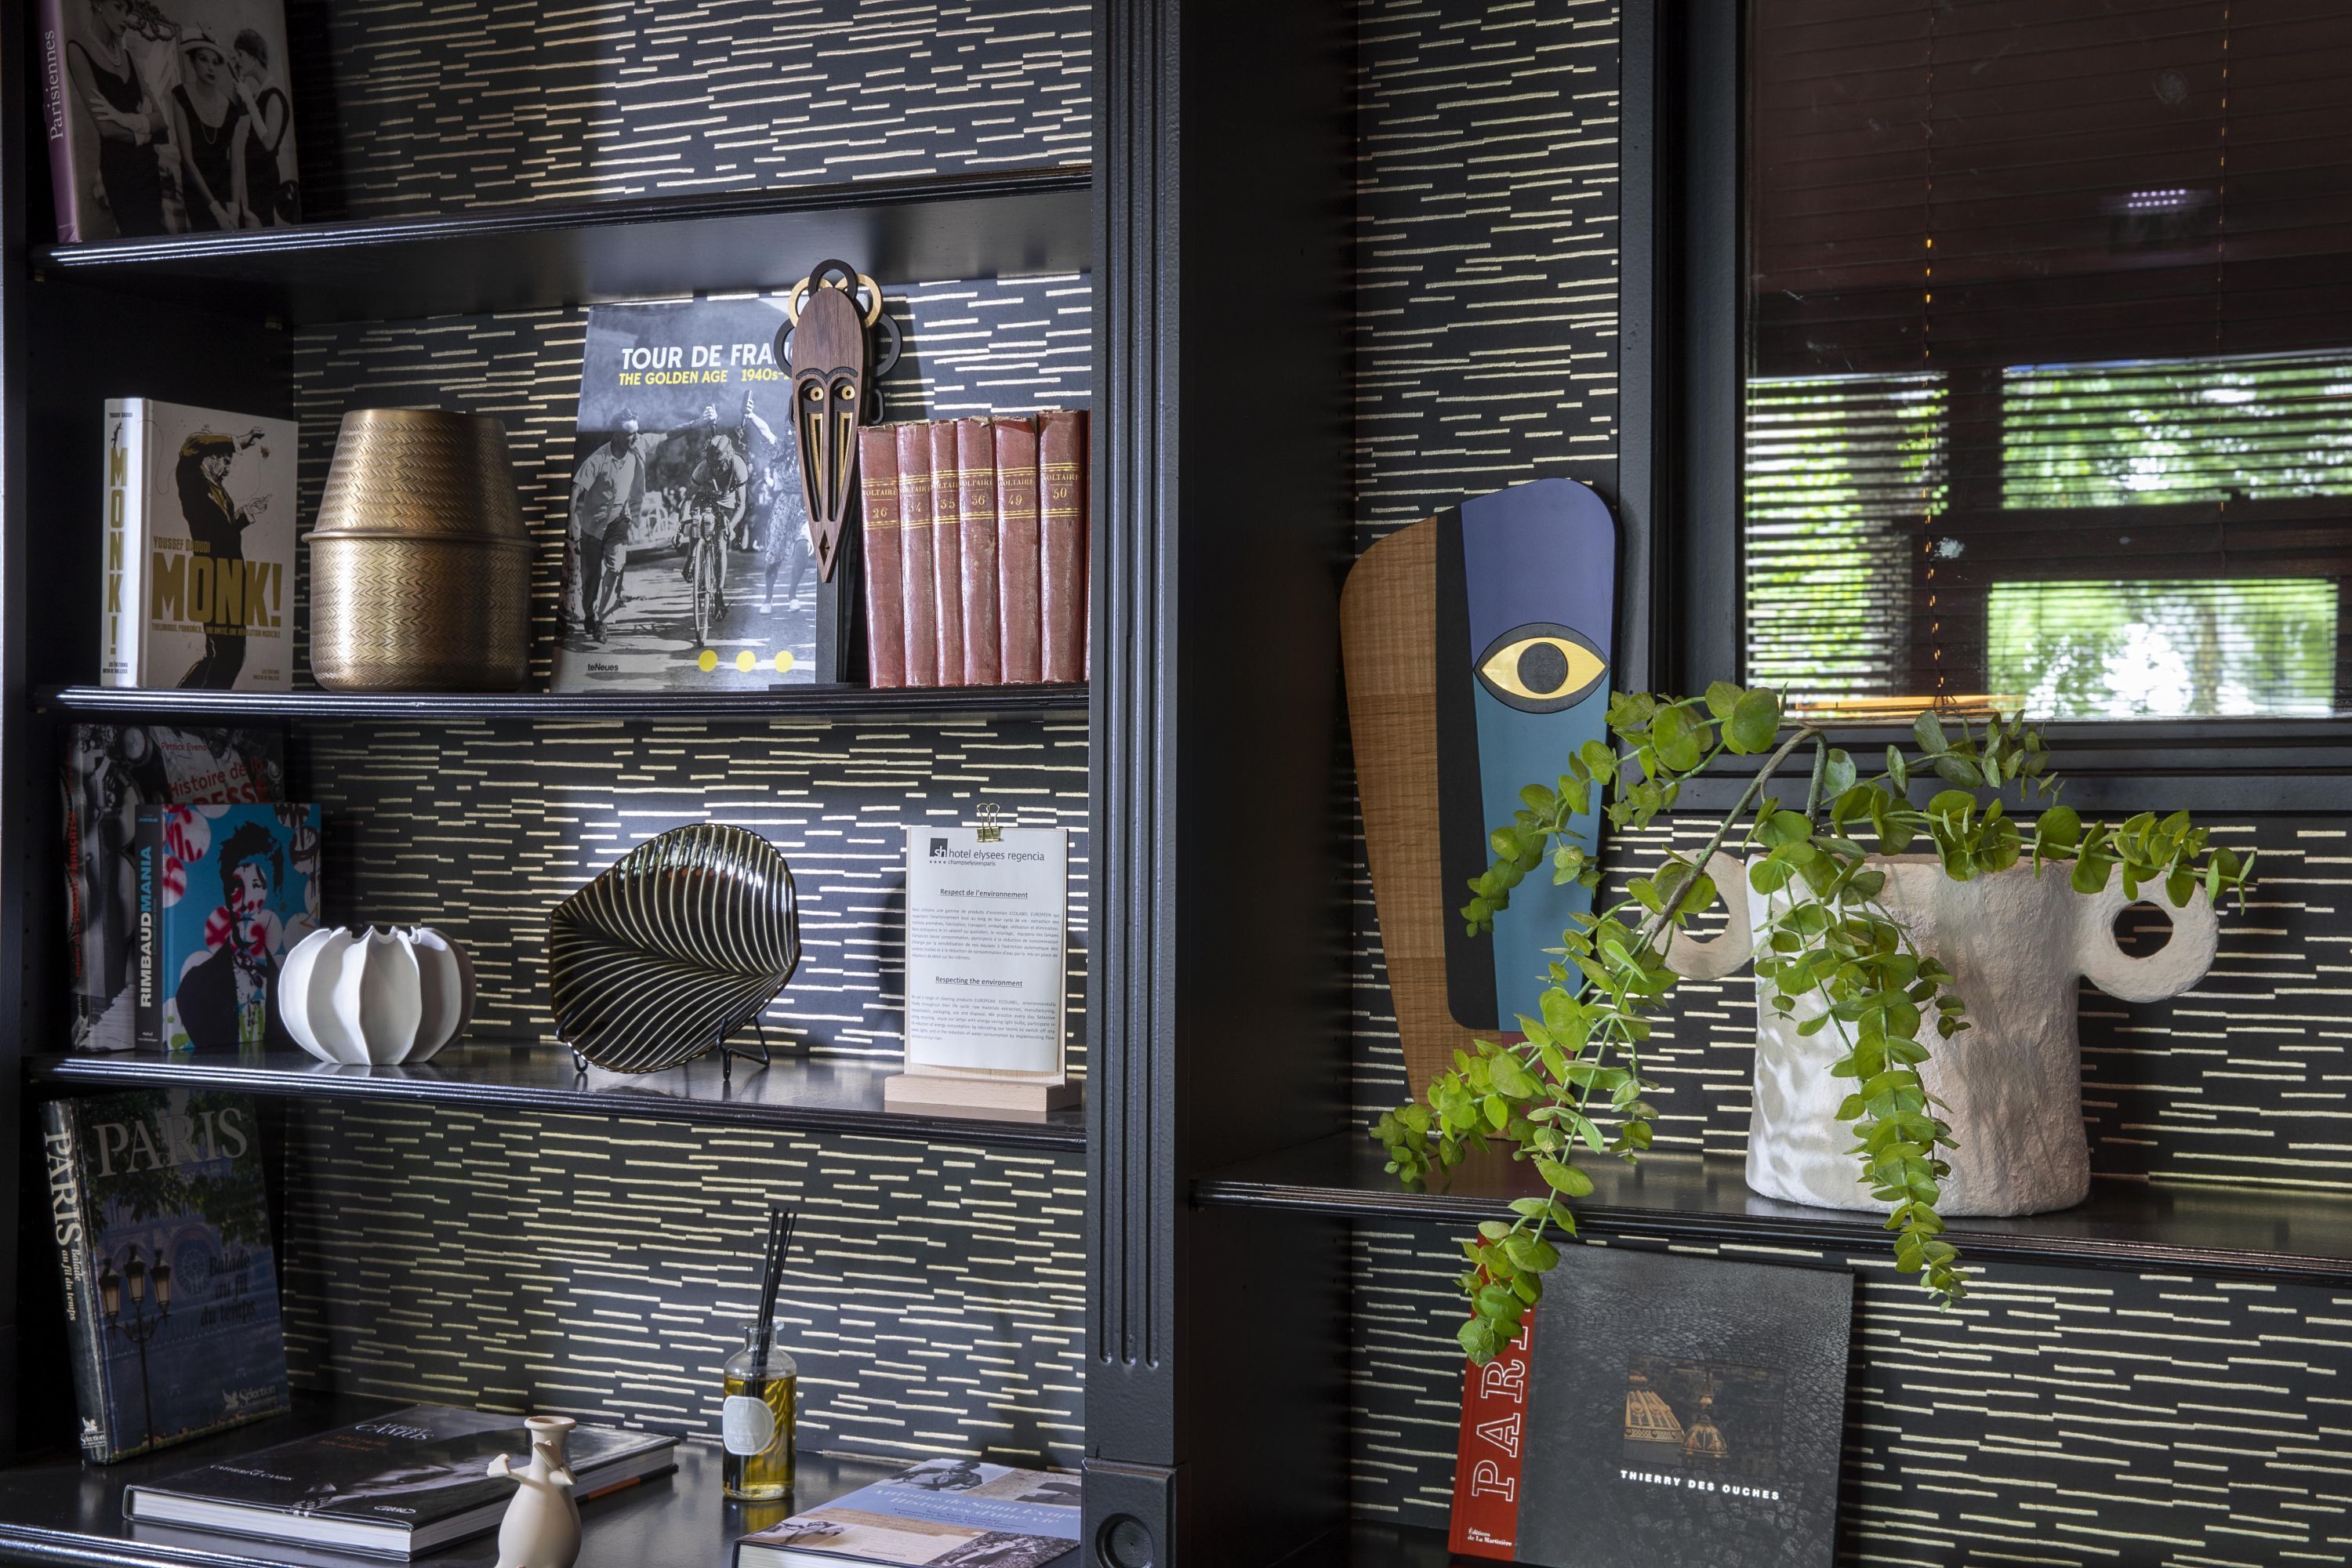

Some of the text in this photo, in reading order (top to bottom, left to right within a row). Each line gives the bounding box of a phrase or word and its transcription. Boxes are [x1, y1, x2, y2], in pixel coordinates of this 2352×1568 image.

[45, 30, 64, 141] Parisiennes
[622, 347, 683, 370] TOUR
[691, 345, 723, 368] DE
[619, 372, 642, 386] THE
[645, 371, 698, 385] GOLDEN
[702, 370, 728, 383] AGE
[971, 495, 985, 506] 36
[1007, 495, 1022, 506] 49
[1053, 488, 1067, 499] 50
[873, 507, 887, 517] 26
[909, 502, 921, 513] 34
[940, 498, 956, 510] 35
[154, 535, 211, 553] YOUSSEF DAOUDI
[151, 552, 282, 628] MONK!
[162, 742, 208, 751] Patrick Eveno
[168, 756, 264, 798] Histoire de la
[934, 846, 1045, 862] sh hotel elysees regencia
[975, 890, 1028, 898] l'environnement
[140, 846, 151, 1007] RIMBAUDMANIA
[935, 976, 968, 985] Respecting
[982, 978, 1023, 987] environment
[92, 1107, 248, 1178] PARIS
[45, 1128, 82, 1247] PARIS
[71, 1247, 82, 1282] Balade
[209, 1251, 251, 1277] Balade
[62, 1250, 76, 1321] au fil du temps
[215, 1273, 249, 1302] au fil
[200, 1299, 256, 1327] du temps
[1620, 1470, 1780, 1501] THIERRY DES OUCHES
[971, 1501, 1018, 1512] Saint
[1468, 1526, 1490, 1537] Éditions
[1484, 1537, 1512, 1546] Martinière
